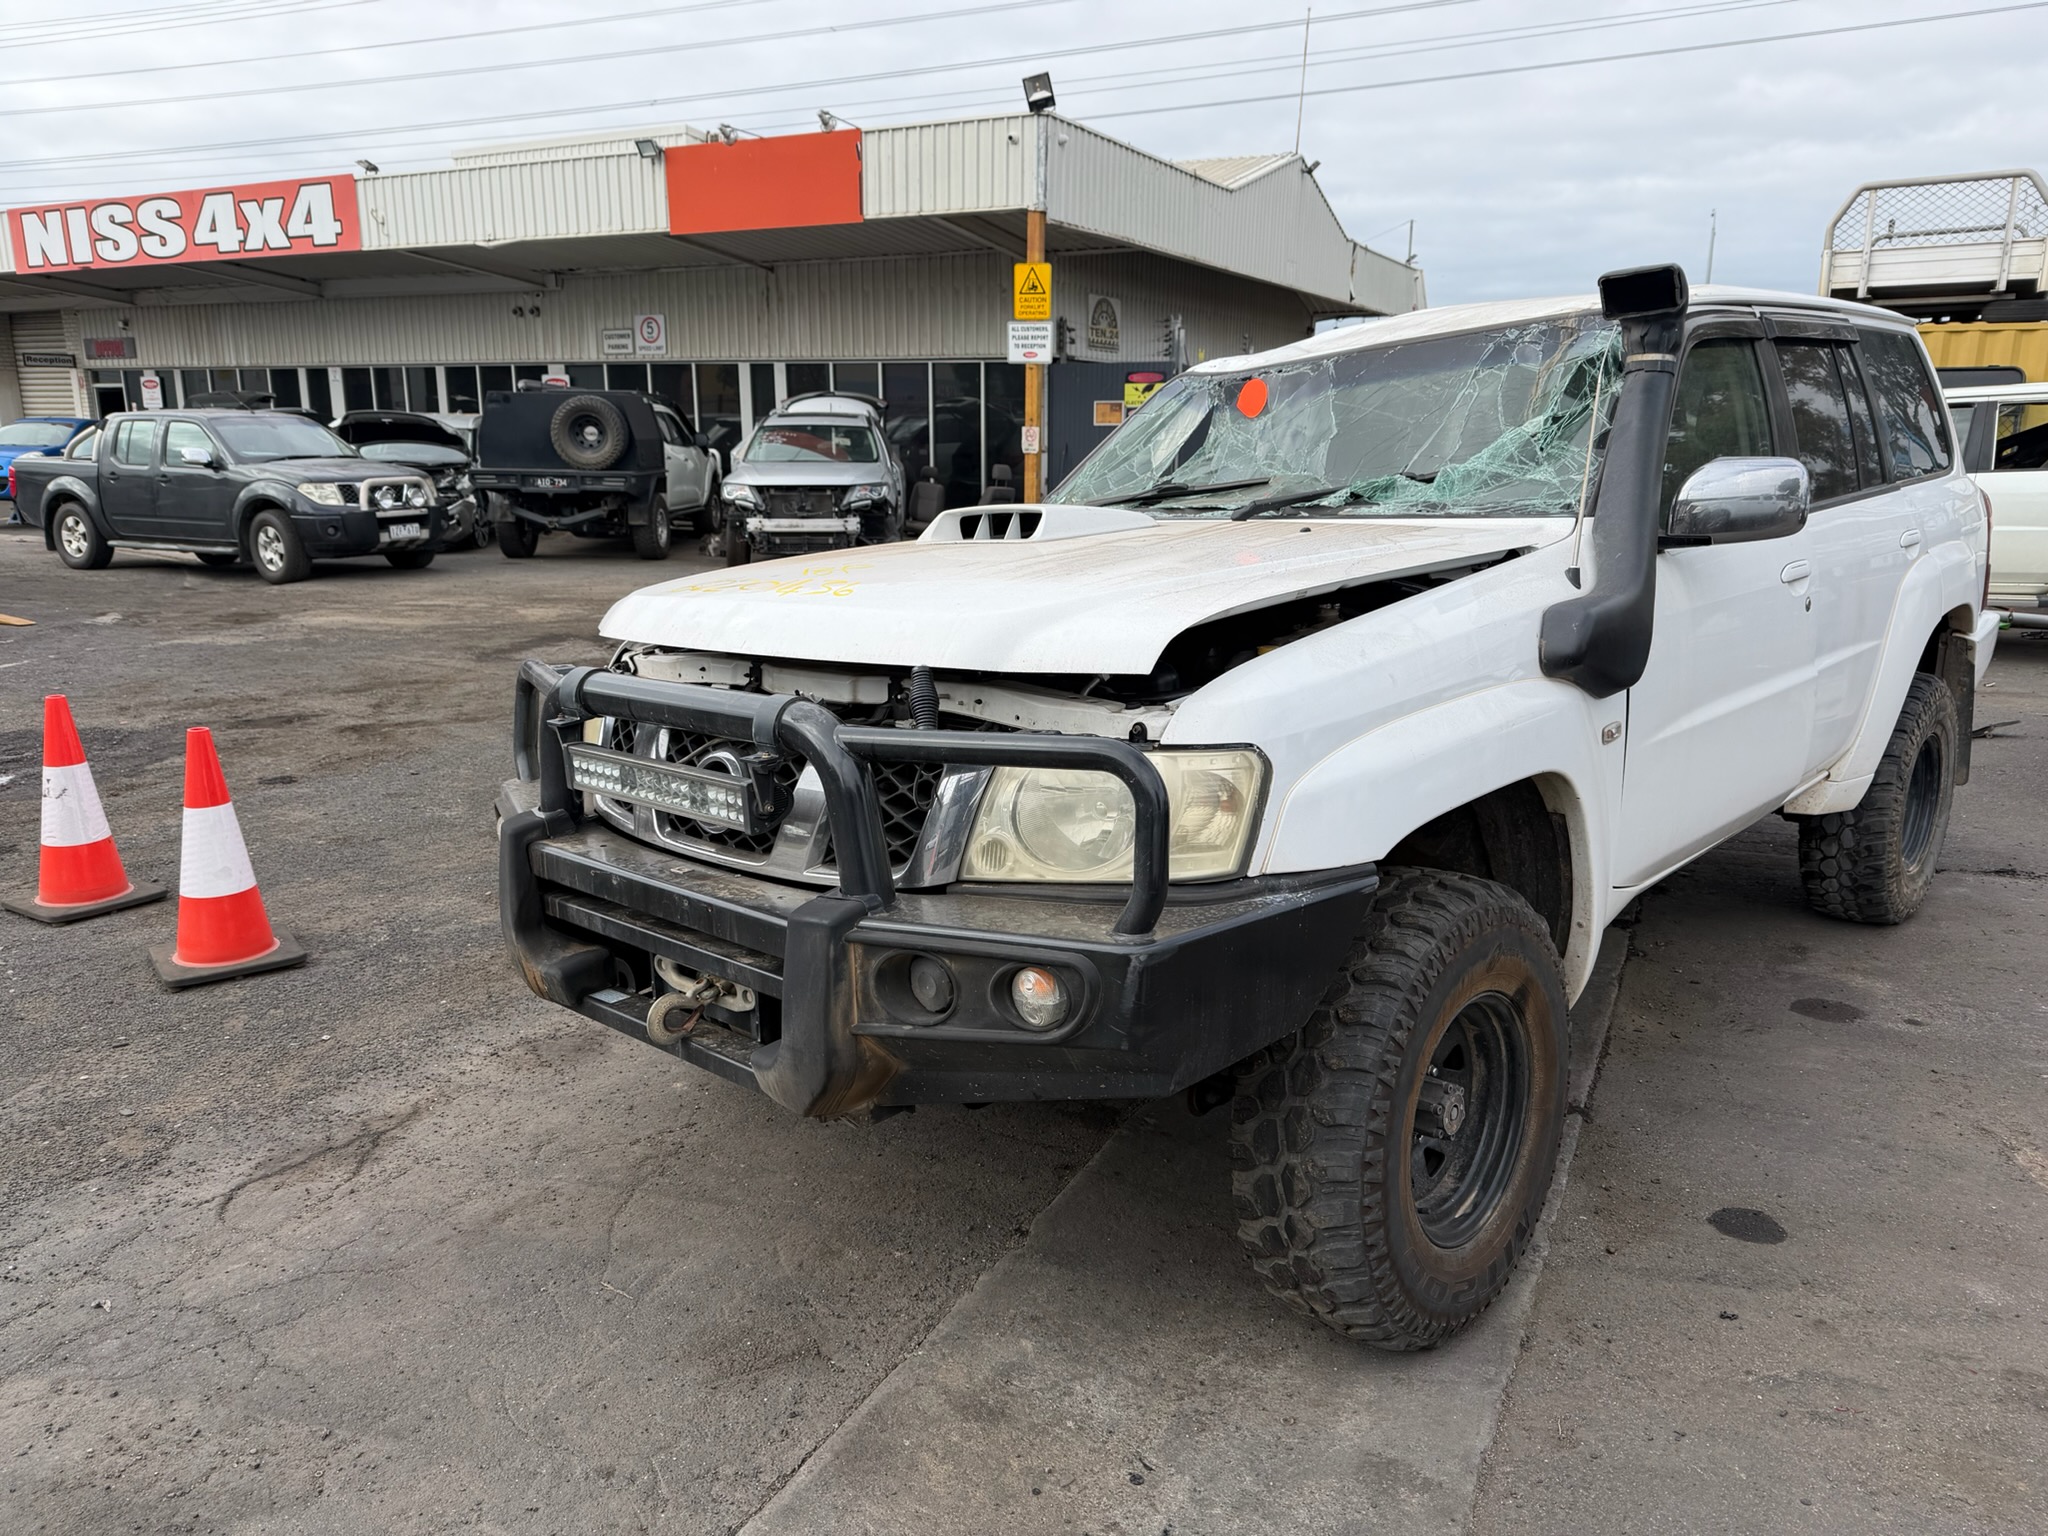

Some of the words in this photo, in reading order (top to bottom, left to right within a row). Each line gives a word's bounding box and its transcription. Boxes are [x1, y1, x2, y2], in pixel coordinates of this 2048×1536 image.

[19, 196, 187, 268] NISS
[193, 182, 343, 254] 4x4
[646, 321, 654, 335] 5
[26, 355, 73, 366] Reception
